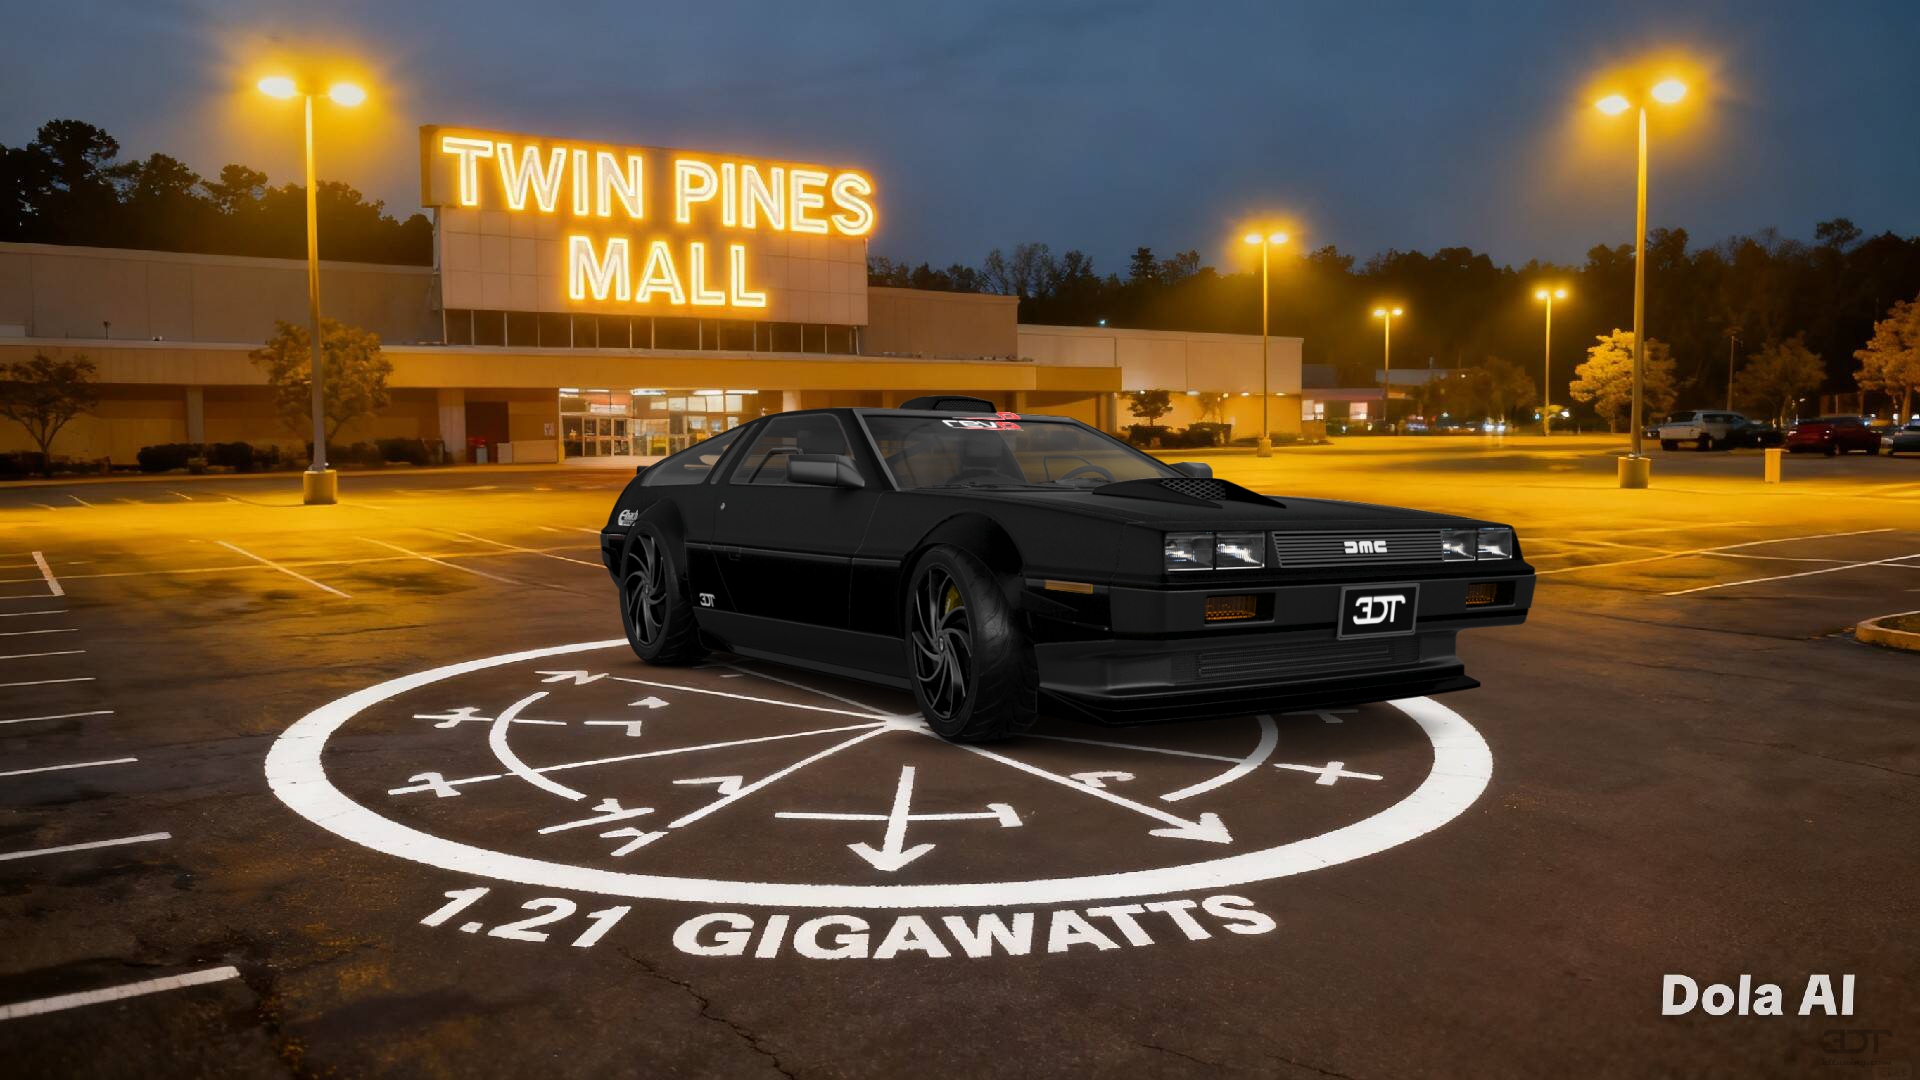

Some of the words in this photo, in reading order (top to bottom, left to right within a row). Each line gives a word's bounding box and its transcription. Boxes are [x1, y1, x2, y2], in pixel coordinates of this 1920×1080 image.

[442, 136, 644, 219] TWIN
[675, 159, 875, 236] PINES
[568, 235, 767, 308] MALL
[1352, 594, 1406, 625] 3DT
[419, 886, 632, 948] 1.21
[672, 895, 1277, 960] GIGAWATTS
